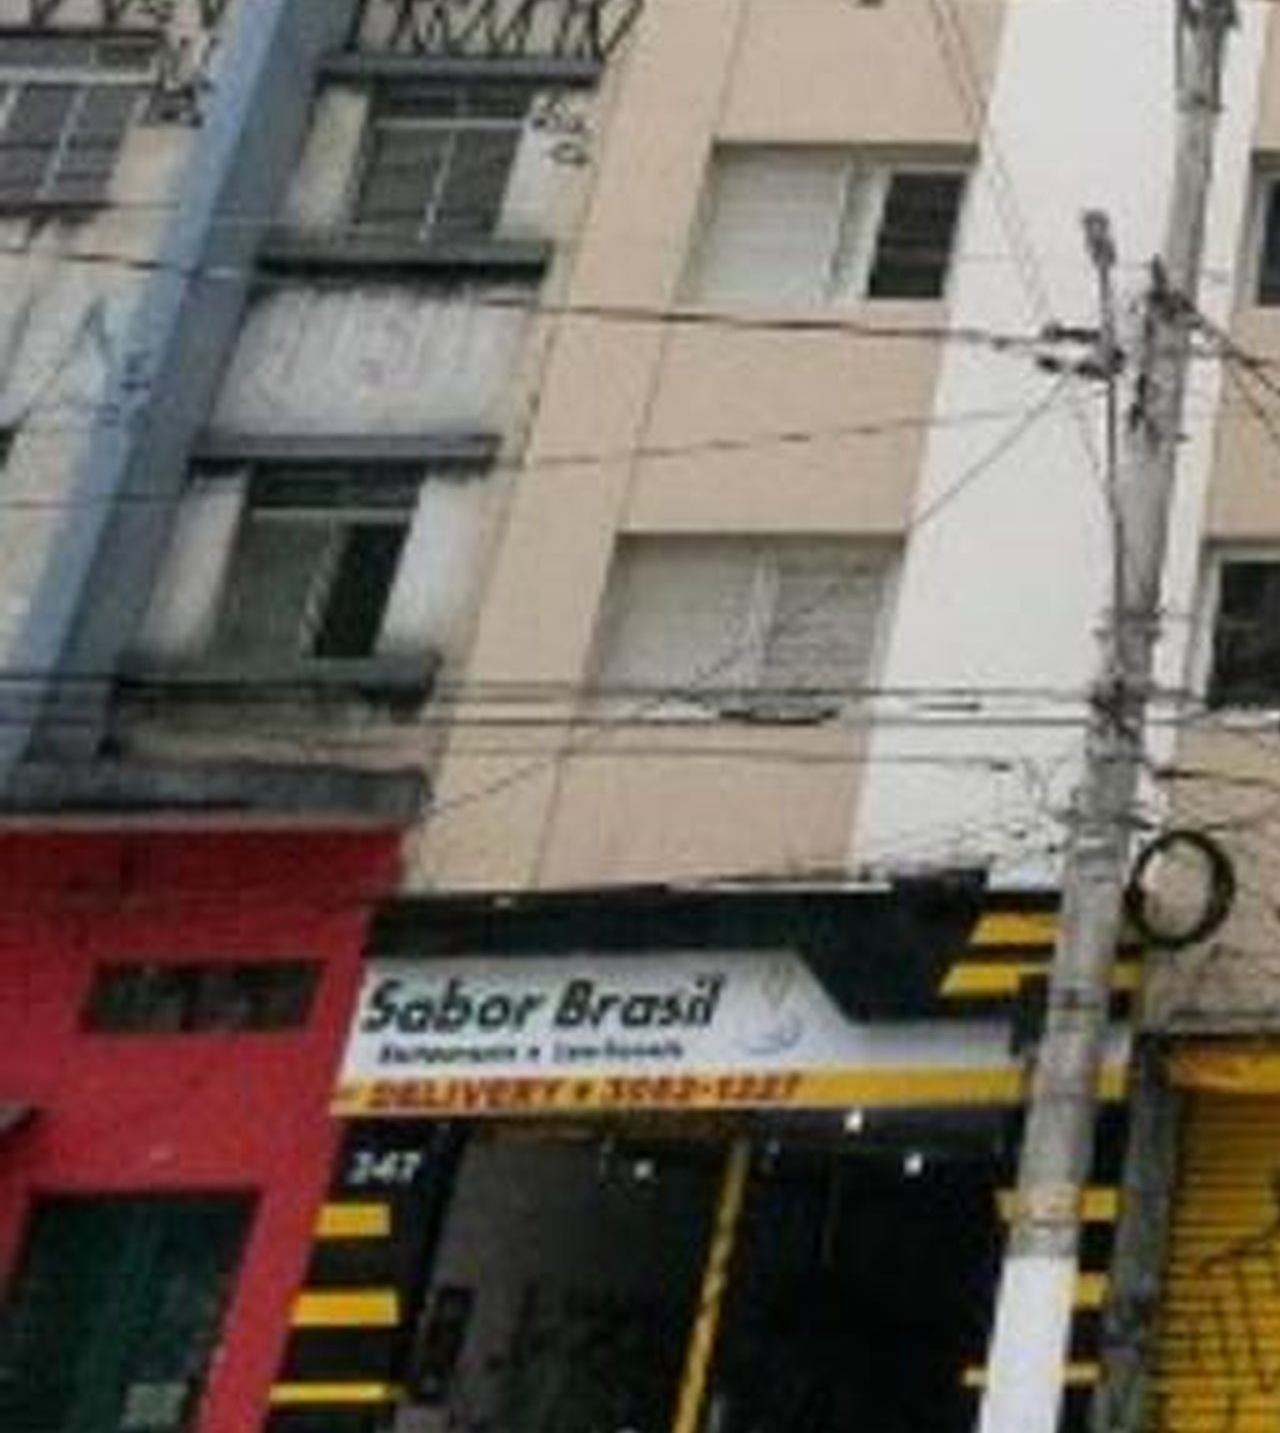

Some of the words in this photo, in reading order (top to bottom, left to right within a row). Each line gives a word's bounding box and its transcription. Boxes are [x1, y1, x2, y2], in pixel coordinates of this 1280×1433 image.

[364, 978, 544, 1033] Sabor
[554, 973, 725, 1027] Brasil
[366, 1077, 562, 1108] DELIVERY
